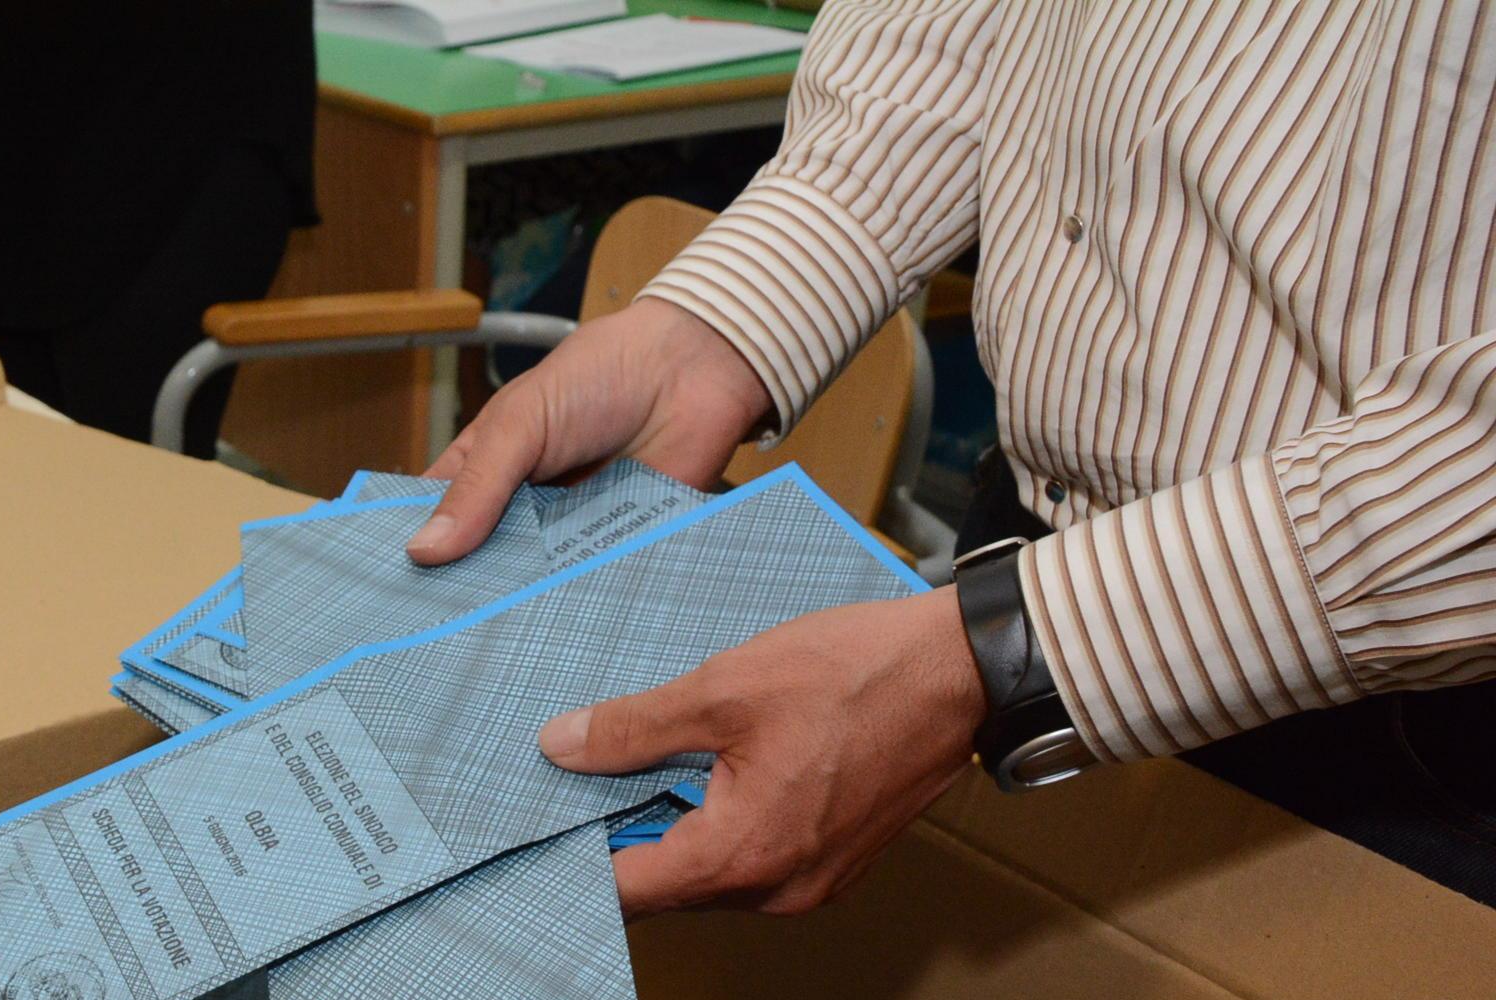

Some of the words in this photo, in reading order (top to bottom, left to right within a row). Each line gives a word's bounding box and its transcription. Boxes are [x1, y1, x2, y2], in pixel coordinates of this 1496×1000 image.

[554, 533, 582, 555] DEL
[579, 497, 637, 540] SINDACO
[593, 502, 664, 552] COMUNALE
[662, 492, 680, 510] DI
[264, 722, 282, 735] E
[270, 732, 296, 756] DEL
[284, 753, 334, 814] CONSIGLIO
[304, 730, 349, 784] ELEZIONE
[337, 781, 364, 807] DEL
[352, 804, 398, 856] SINDACO
[91, 807, 127, 854] SCHEDA
[202, 814, 214, 824] 5
[243, 808, 280, 852] OLBIA
[206, 822, 233, 856] GIUGNO
[321, 811, 372, 876] COMUNALE
[116, 853, 142, 879] PER
[225, 853, 247, 879] 2016
[361, 873, 383, 891] DI
[130, 878, 152, 896] LA
[140, 896, 191, 970] VOTAZIONE
